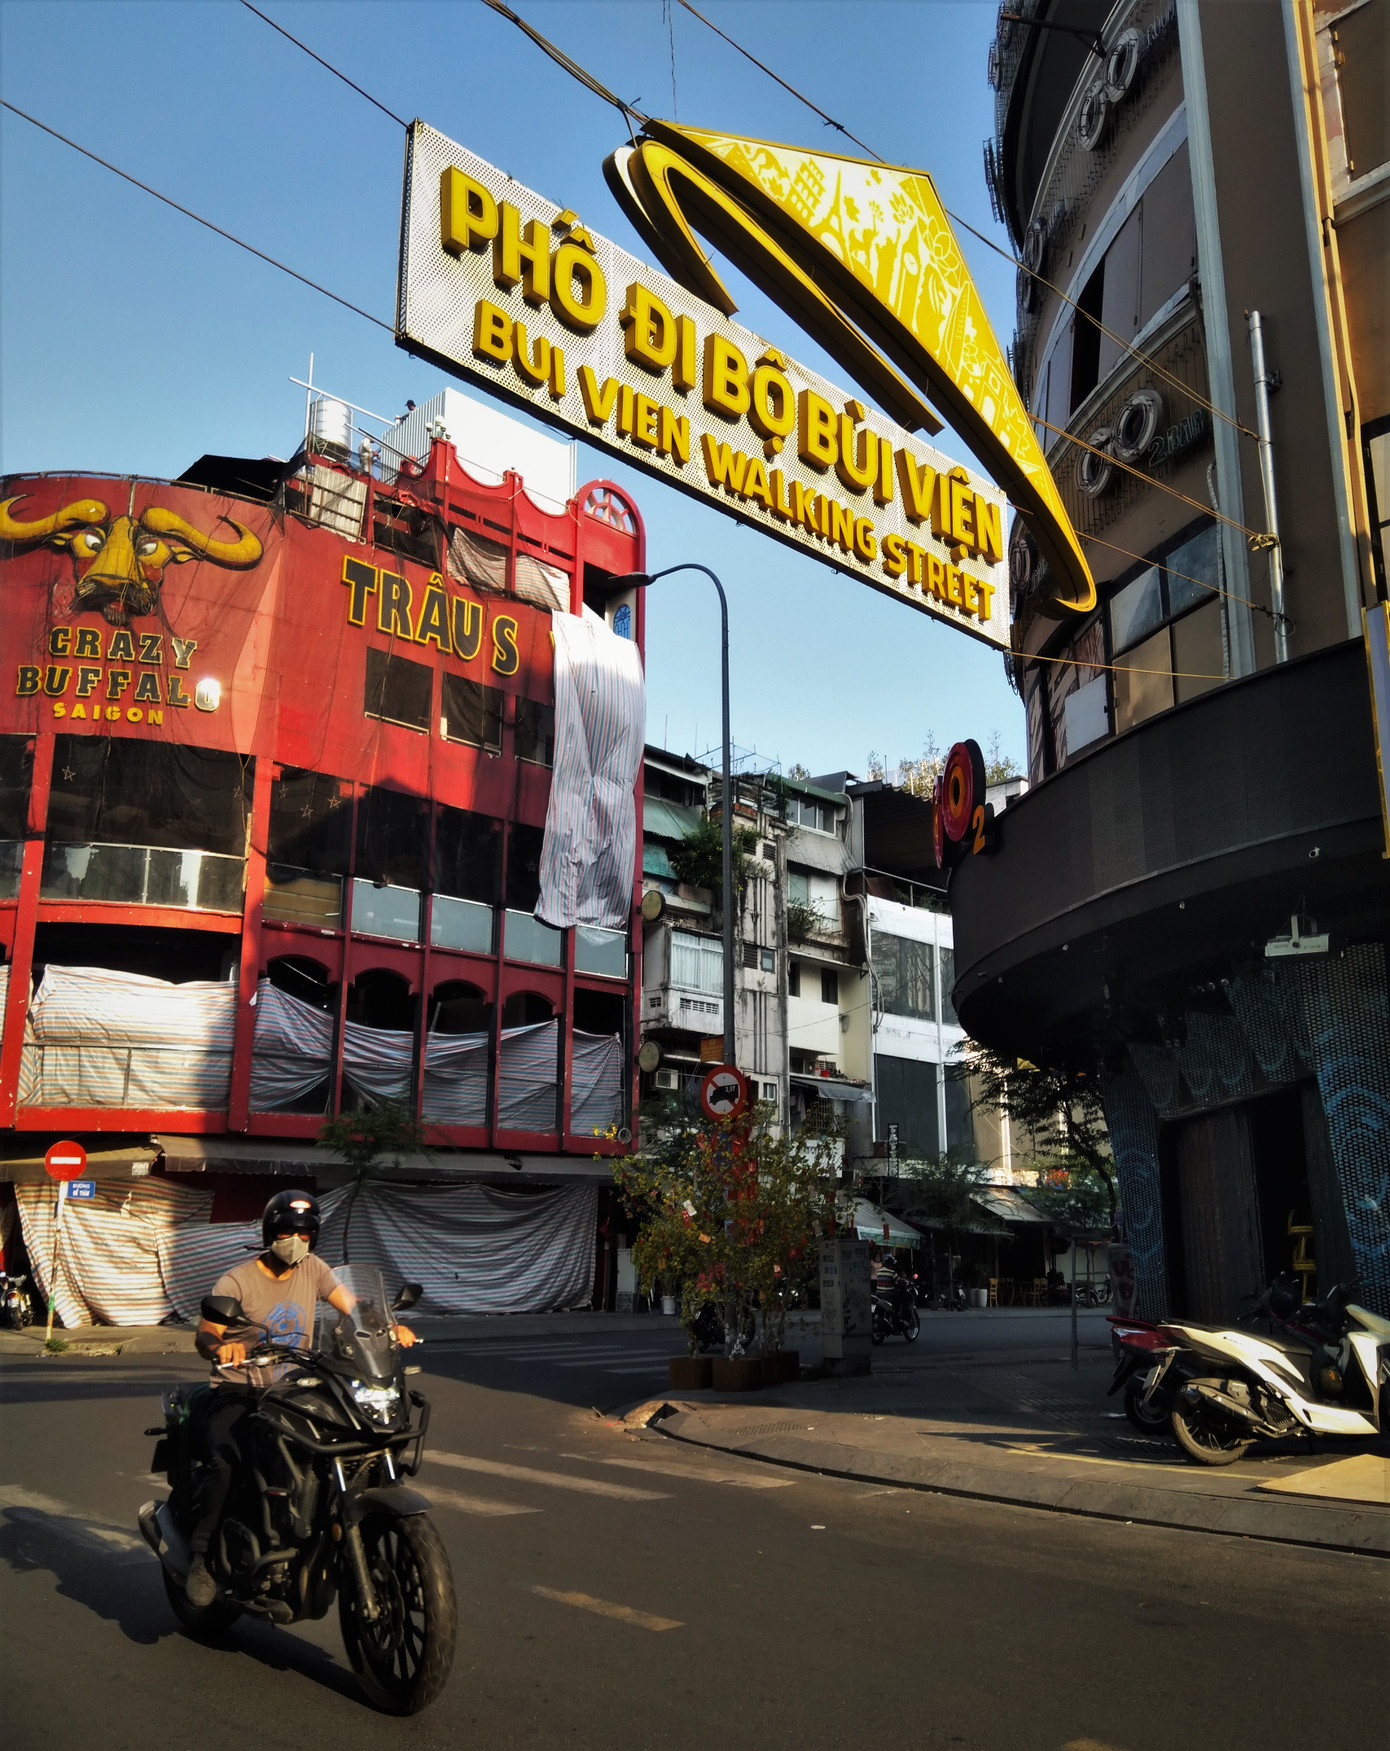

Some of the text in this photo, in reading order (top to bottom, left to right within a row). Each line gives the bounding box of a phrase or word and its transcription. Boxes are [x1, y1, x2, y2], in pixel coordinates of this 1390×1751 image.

[440, 164, 1003, 564] PHỐ ĐI BỘ BÙI VIỆN
[472, 299, 565, 399] BUI
[577, 364, 690, 465] VIEN
[700, 432, 877, 561] WALKING
[882, 532, 994, 623] STREET
[49, 626, 198, 669] CRAZY
[16, 665, 221, 712] BUFFALO
[53, 702, 164, 726] SAIGON
